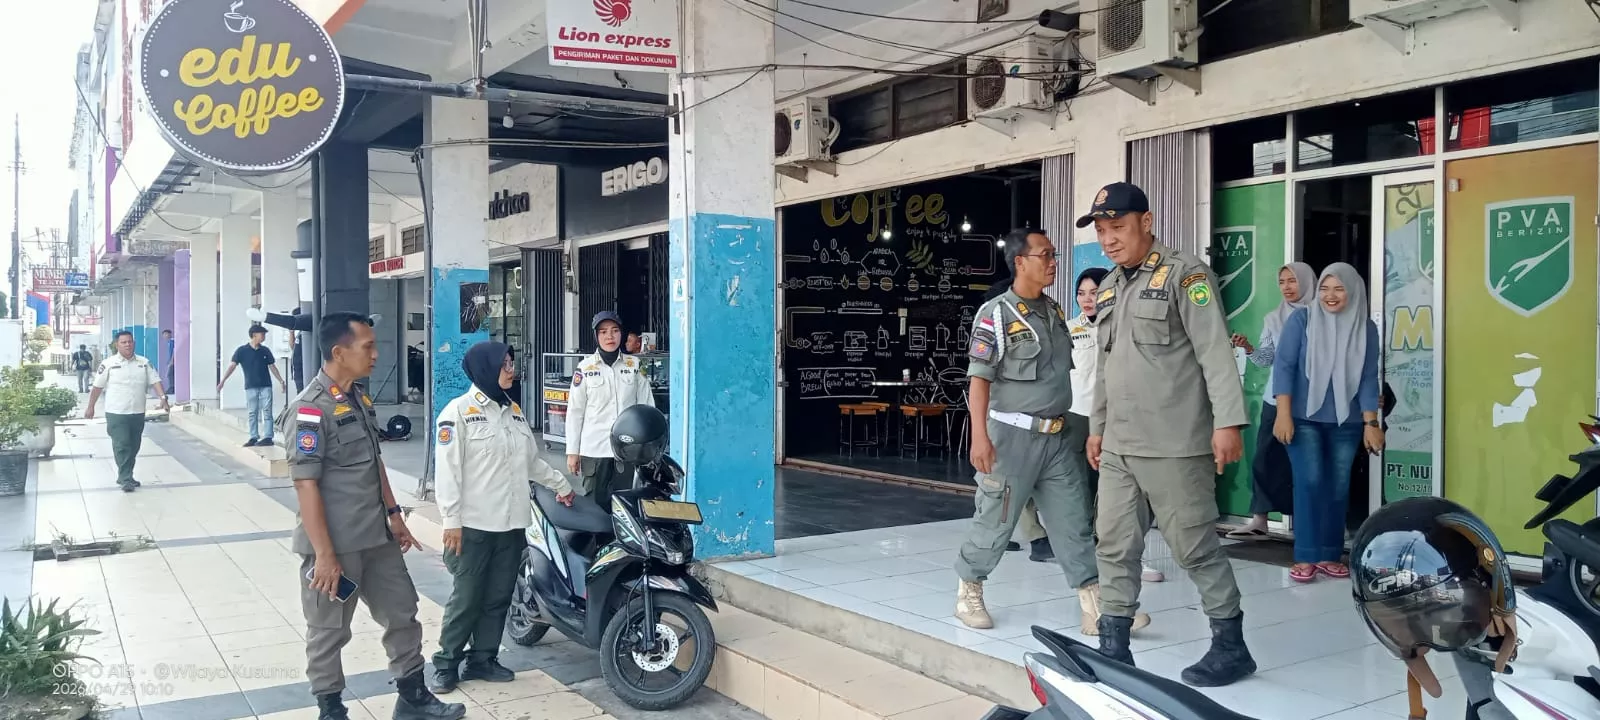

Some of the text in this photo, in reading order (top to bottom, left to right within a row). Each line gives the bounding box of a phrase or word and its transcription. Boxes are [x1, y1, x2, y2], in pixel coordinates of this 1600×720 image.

[559, 27, 671, 48] Lion express
[179, 35, 301, 87] edu
[558, 50, 600, 59] PENGIRIMAN
[603, 53, 623, 61] PAKET
[174, 85, 324, 138] Coffee
[602, 157, 667, 196] ERIGO
[1497, 208, 1560, 230] PVA
[1496, 228, 1563, 238] BERIZIN
[1387, 464, 1433, 480] PT. NU
